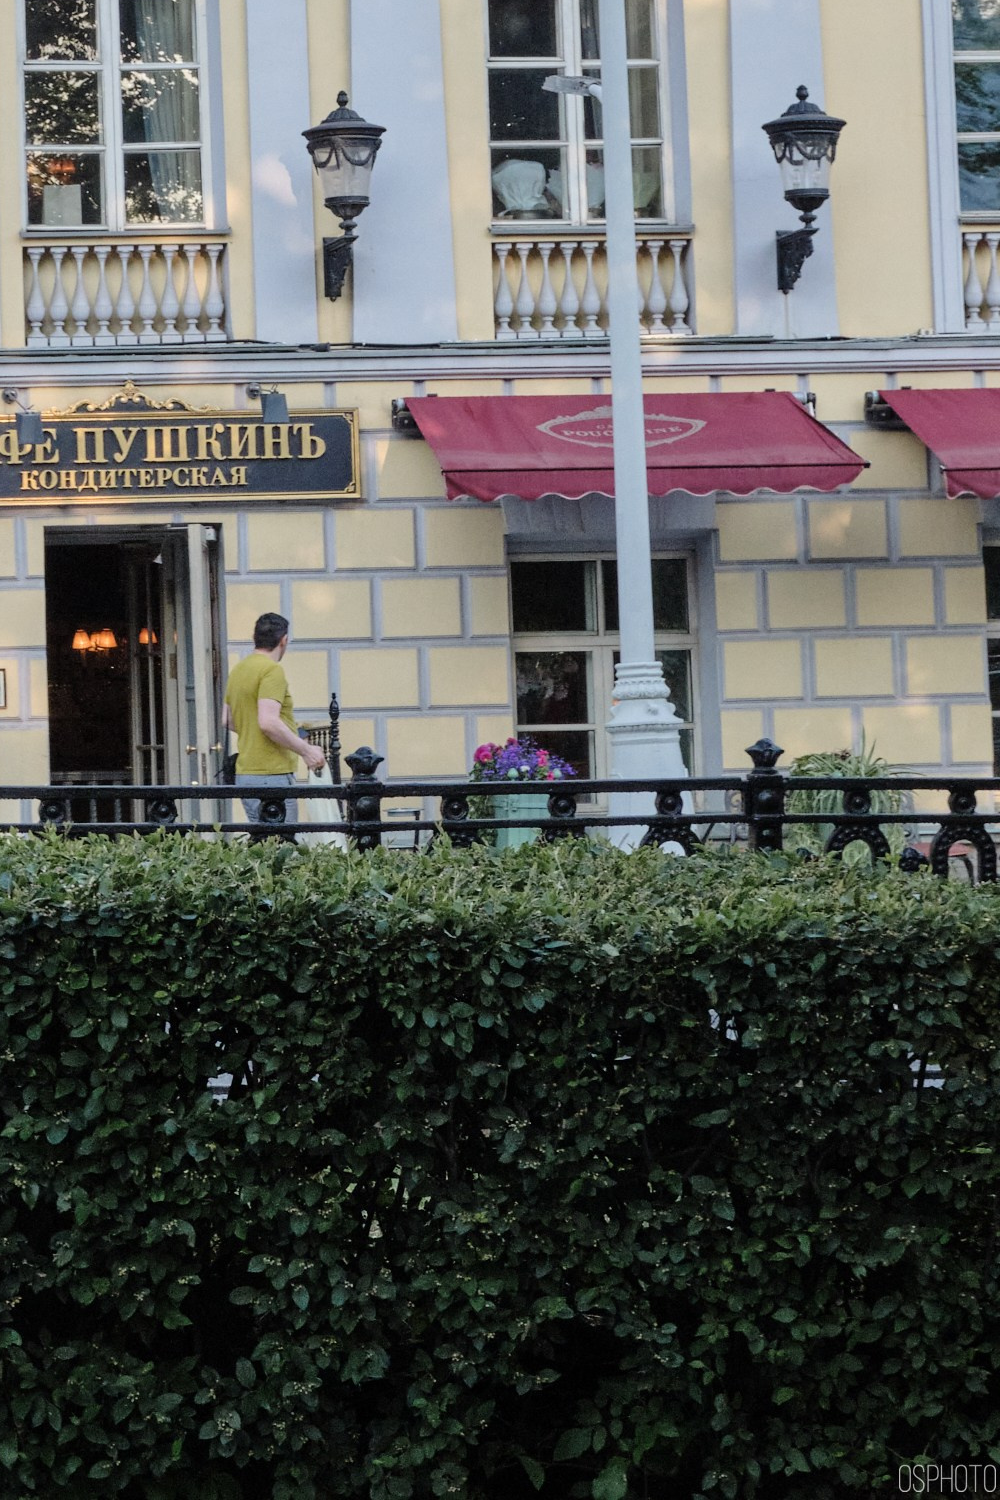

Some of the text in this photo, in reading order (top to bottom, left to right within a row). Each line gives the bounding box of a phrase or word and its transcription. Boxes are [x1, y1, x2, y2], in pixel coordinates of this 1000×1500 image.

[73, 423, 327, 464] ПУШКИНЪ
[562, 426, 682, 437] POUCINE
[20, 467, 248, 492] КОНДИТЕРСКАЯ
